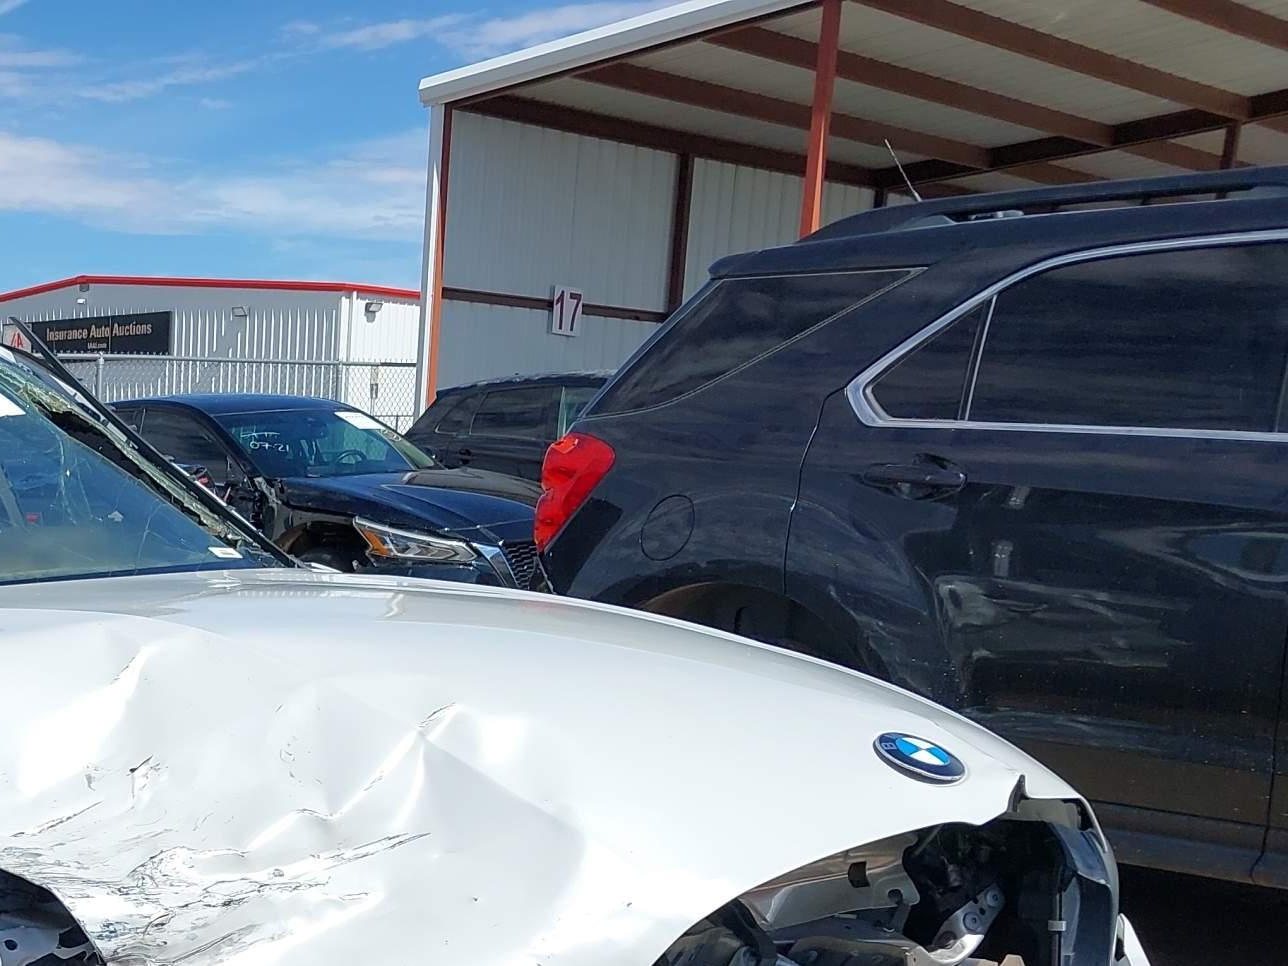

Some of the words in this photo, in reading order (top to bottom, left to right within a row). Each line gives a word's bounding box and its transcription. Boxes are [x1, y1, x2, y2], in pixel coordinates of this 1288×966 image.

[554, 290, 582, 332] 17
[46, 327, 88, 342] Insurance
[89, 324, 110, 339] Auto
[112, 321, 152, 337] Auctions
